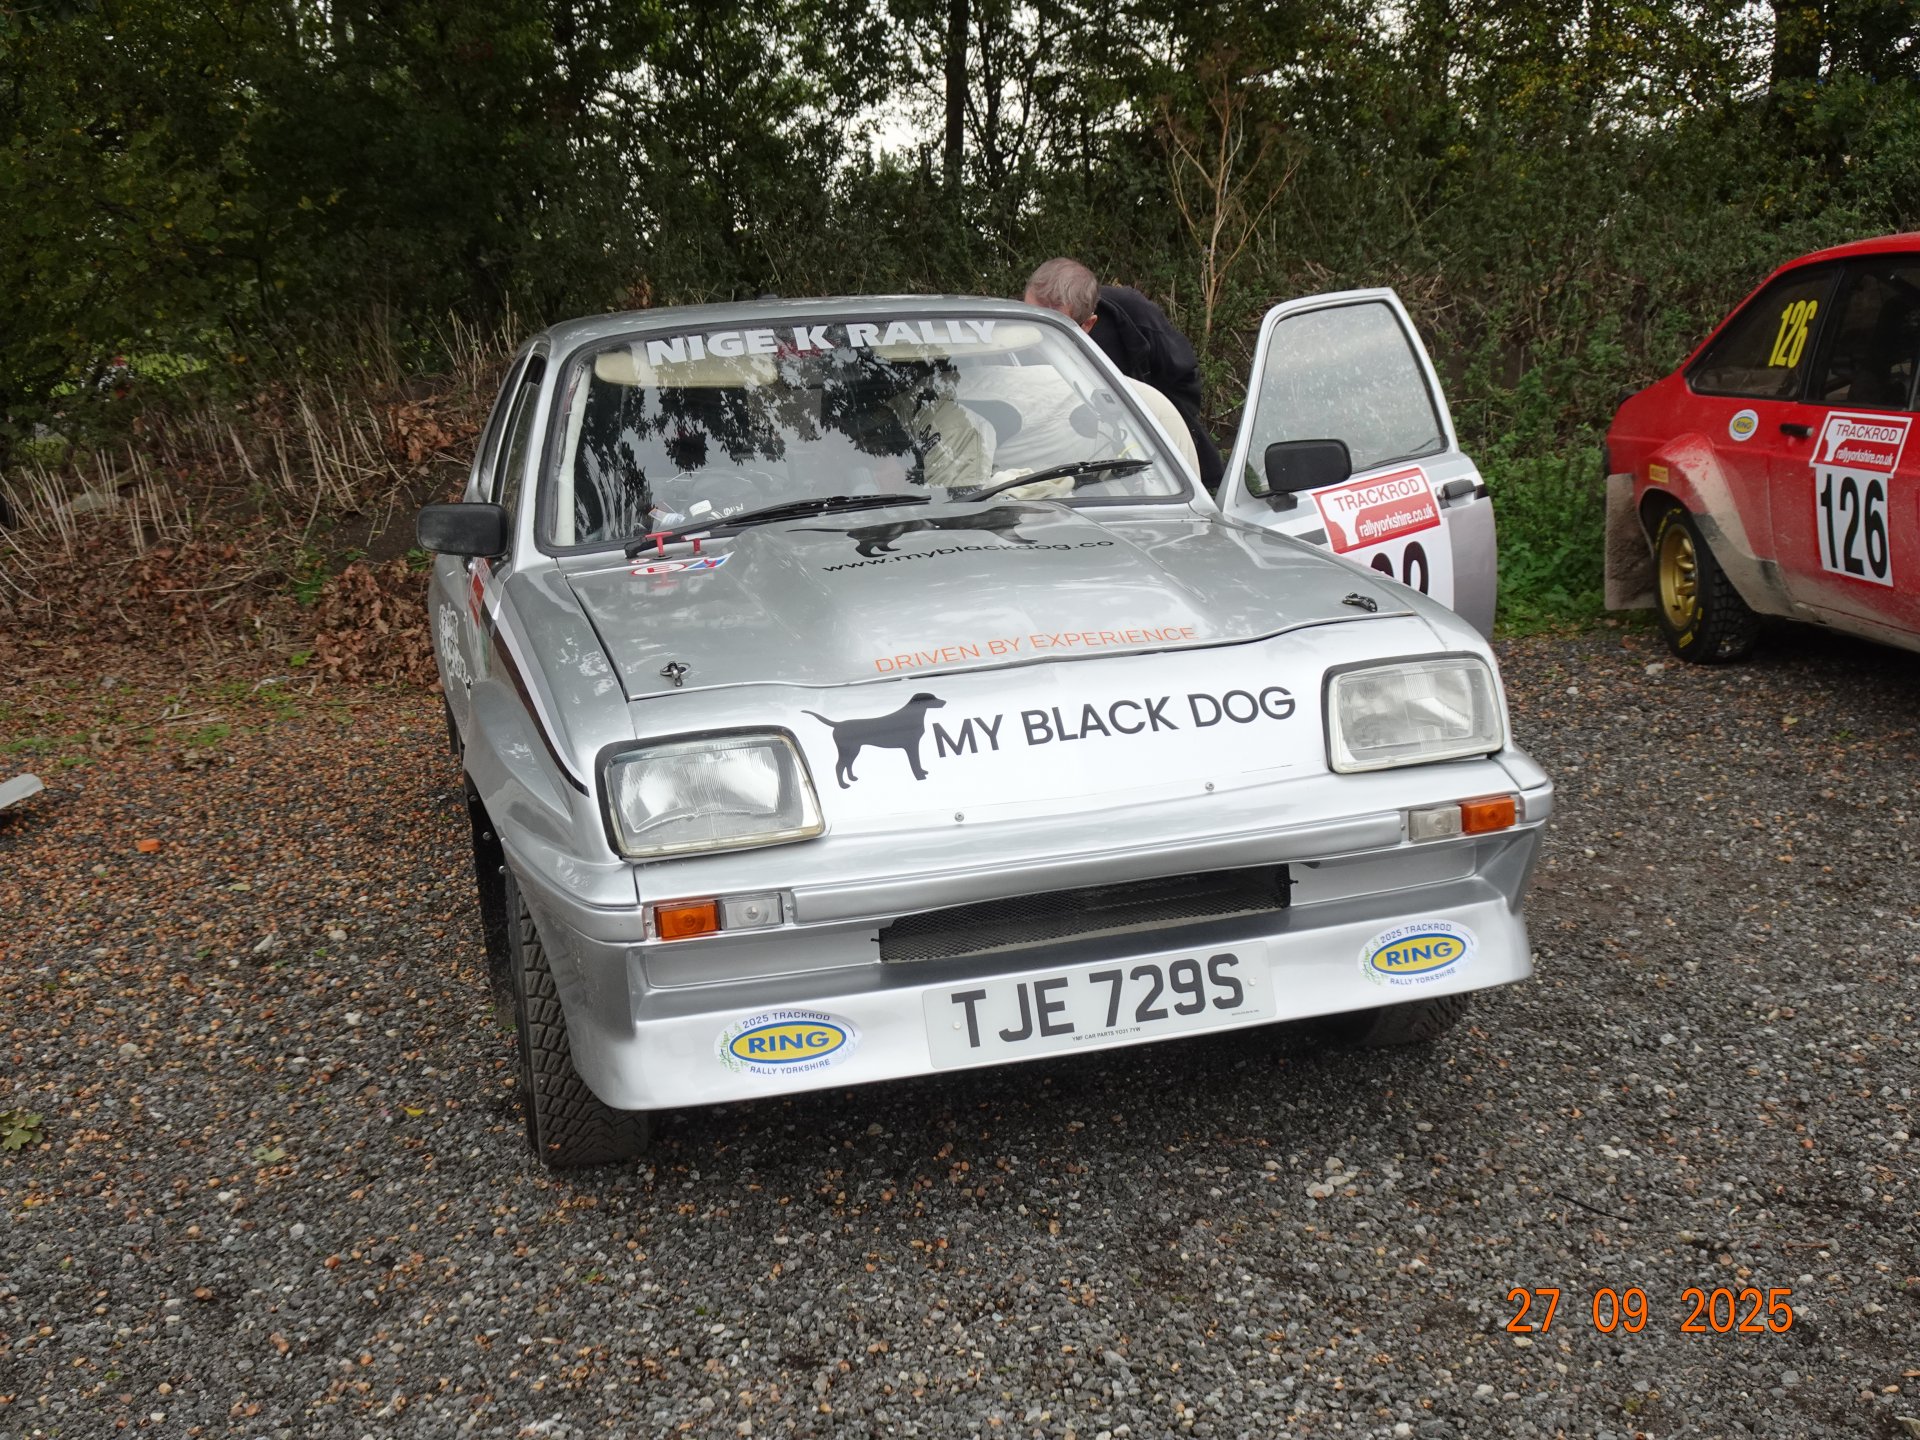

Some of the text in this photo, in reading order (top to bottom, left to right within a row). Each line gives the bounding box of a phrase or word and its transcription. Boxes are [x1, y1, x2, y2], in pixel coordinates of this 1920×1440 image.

[646, 321, 996, 366] NIGE K RALLY
[1768, 300, 1818, 368] 126
[1836, 424, 1898, 442] TRACKROD
[1836, 447, 1894, 466] rallyyorkshire.co.uk
[1333, 478, 1420, 513] TRACKROD
[1359, 504, 1435, 538] rallyyorkshire.co.uk
[1821, 473, 1887, 578] 126
[822, 540, 1115, 572] www.myblackdog.co
[874, 626, 1199, 673] DRIVEN BY EXPERIENCE
[932, 686, 1297, 759] MY BLACK DOG
[1380, 923, 1452, 944] 2025 TRACKROD
[1385, 941, 1454, 967] RING
[1390, 966, 1456, 985] RALLY YORKSHIRE
[951, 952, 1245, 1049] TJE 729S
[742, 1011, 831, 1029] 2025 TRACKROD
[748, 1031, 830, 1054] RING
[750, 1058, 830, 1075] RALLY YORKSHIRE
